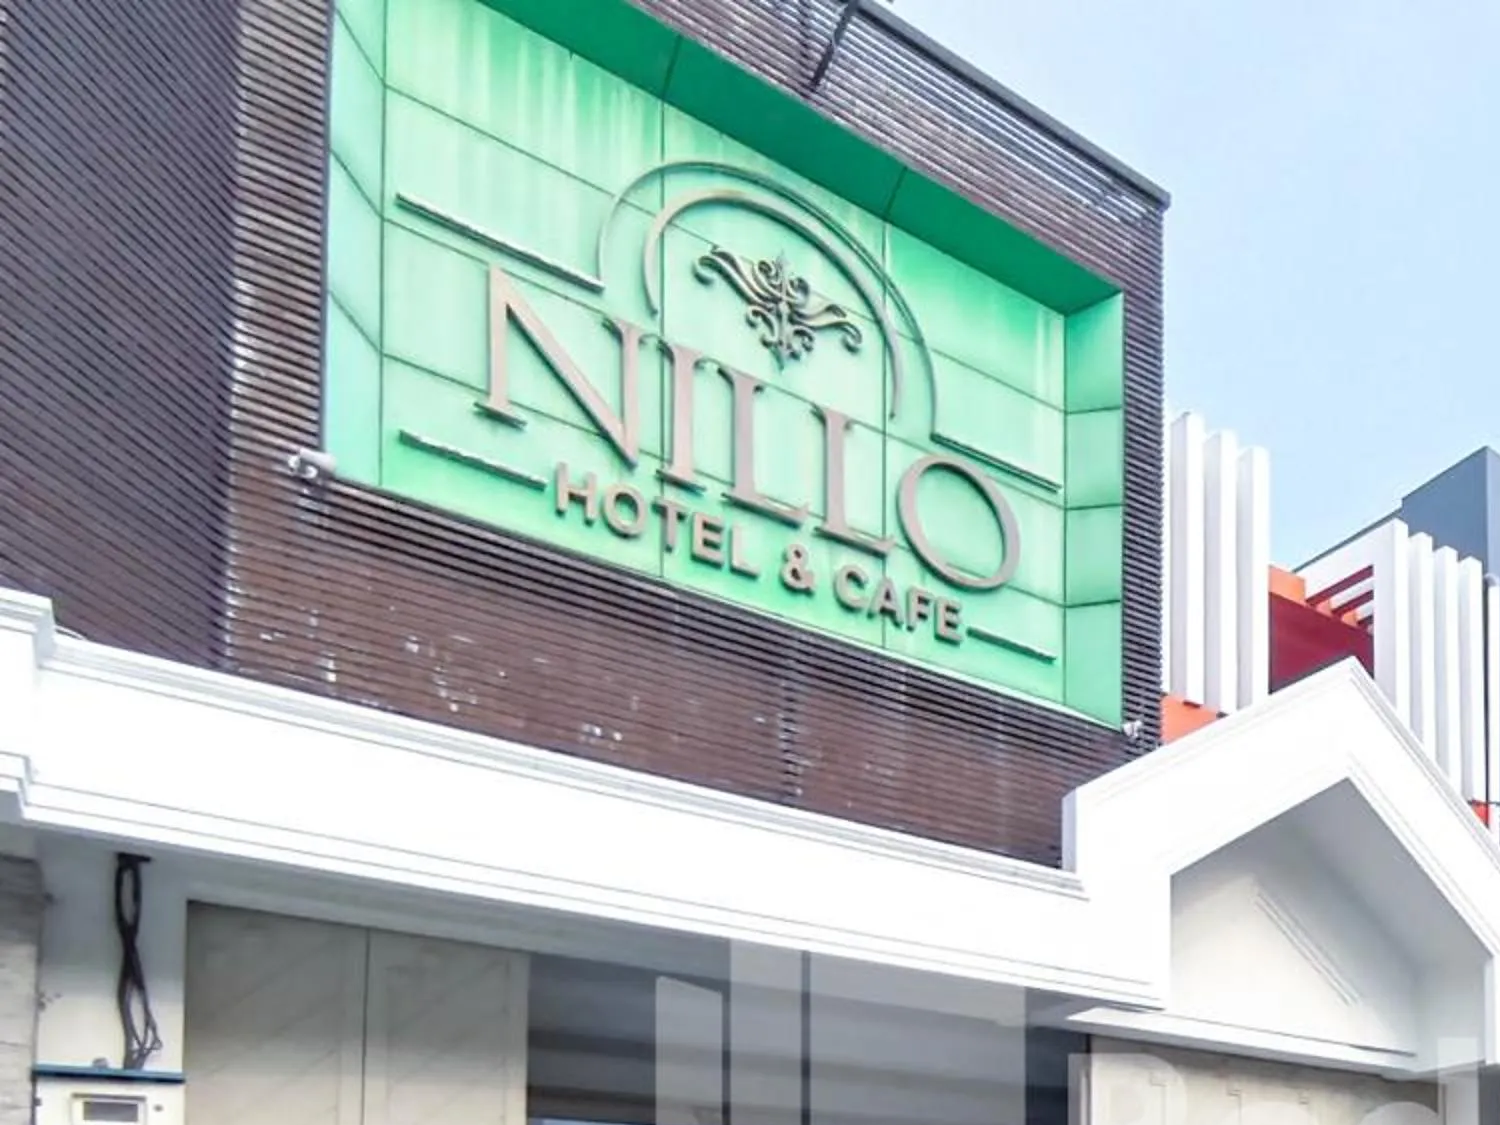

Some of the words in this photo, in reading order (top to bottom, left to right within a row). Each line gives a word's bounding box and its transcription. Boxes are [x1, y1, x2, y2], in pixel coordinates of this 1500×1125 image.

[474, 260, 1021, 593] NILLO
[554, 461, 760, 581] HOTEL
[781, 542, 817, 596] &
[833, 563, 964, 644] CAFE
